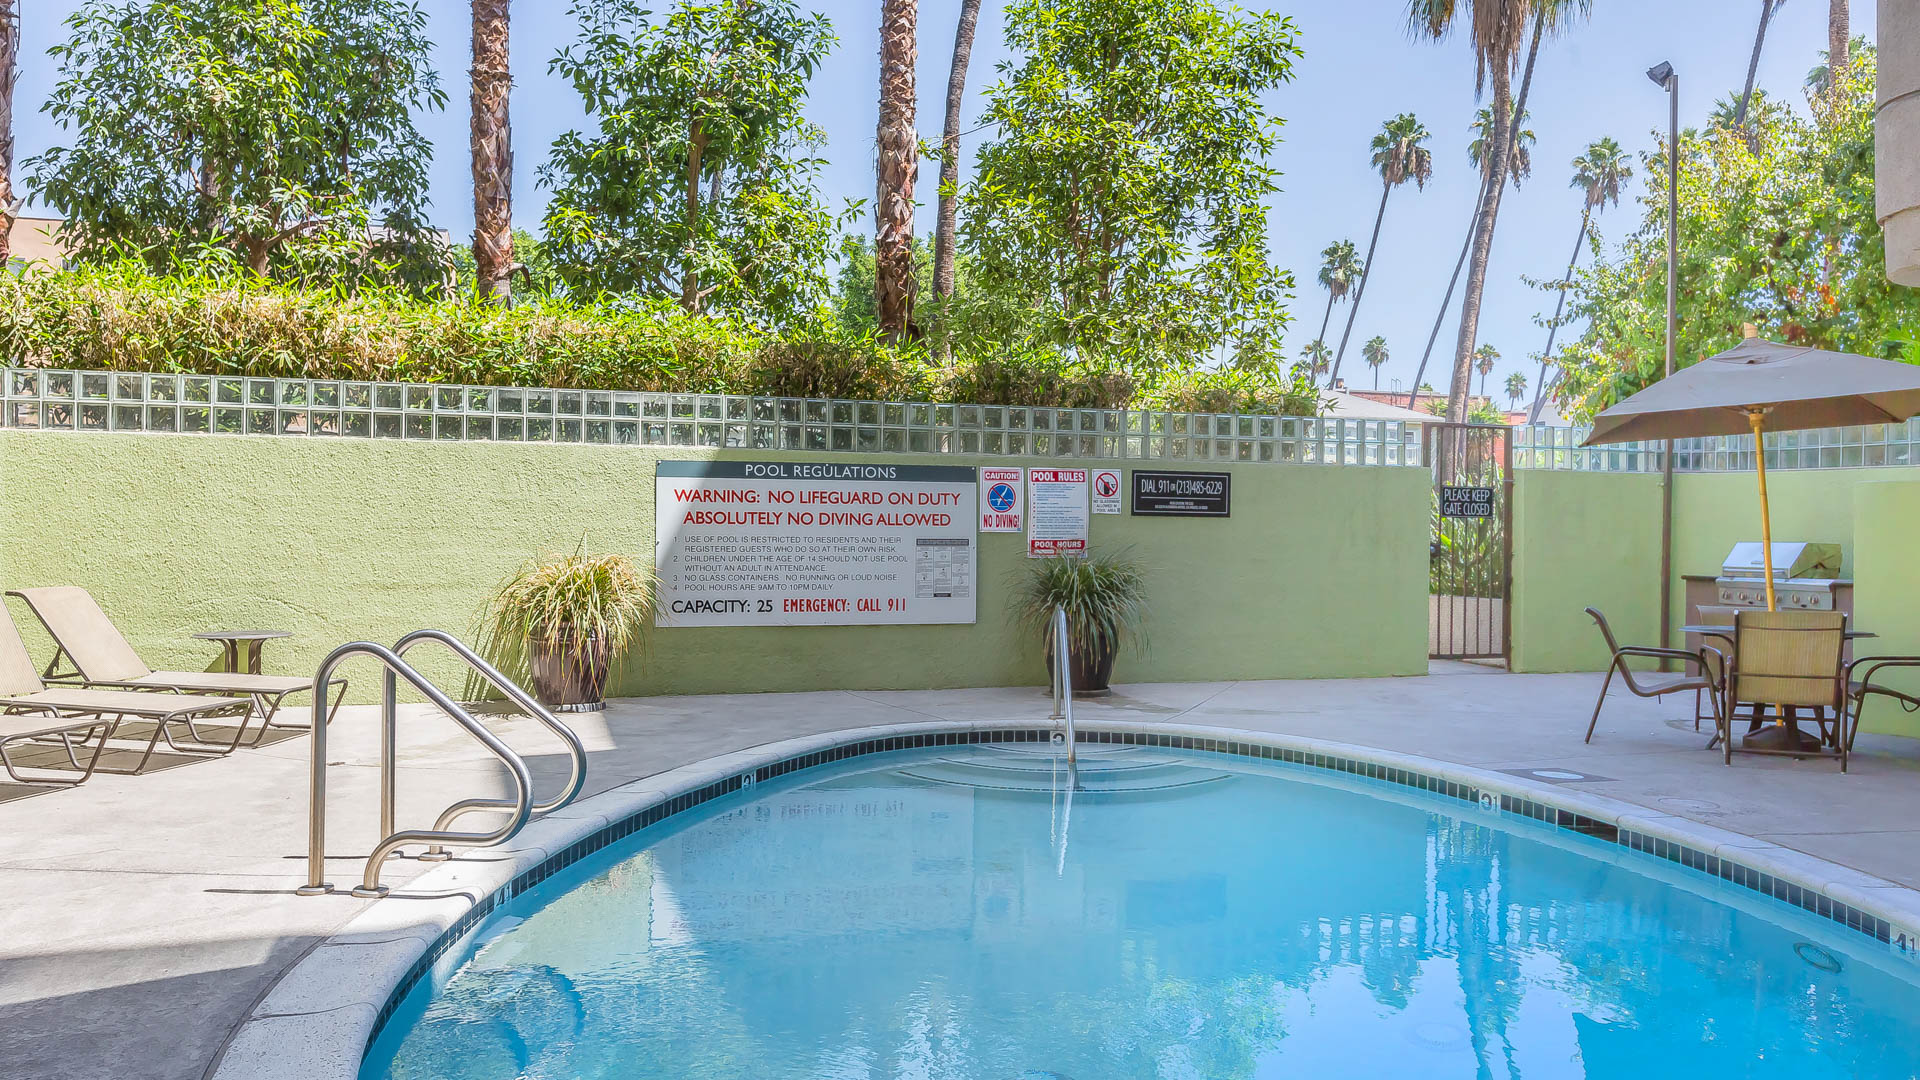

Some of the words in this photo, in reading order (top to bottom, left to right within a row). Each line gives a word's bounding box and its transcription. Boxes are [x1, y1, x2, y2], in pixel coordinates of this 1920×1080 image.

[745, 465, 788, 477] POOL
[793, 466, 897, 479] REGULATIONS
[1032, 472, 1055, 482] POOL
[1058, 472, 1084, 482] RULES
[1141, 479, 1156, 493] DIAL
[1159, 480, 1170, 492] 911
[1176, 480, 1222, 495] (213)485-6229
[674, 488, 760, 504] WARNING:
[768, 491, 795, 504] NO
[800, 491, 884, 505] LIFEGUARD
[888, 492, 915, 505] ON
[918, 493, 961, 506] DUTY
[1444, 489, 1470, 501] PLEASE
[1472, 490, 1490, 501] KEEP
[1444, 503, 1462, 514] GATE
[1463, 503, 1489, 515] CLOSED
[683, 512, 783, 525] ABSOLUTELY
[787, 512, 814, 525] NO
[818, 513, 873, 526] DIVING
[876, 513, 951, 526] ALLOWED
[984, 516, 993, 528] NO
[996, 514, 1020, 528] DIVING!
[672, 600, 750, 613] CAPACITY:
[757, 600, 773, 612] 25
[784, 599, 850, 612] EMERGENCY:
[857, 599, 881, 612] CALL
[888, 598, 906, 611] 911
